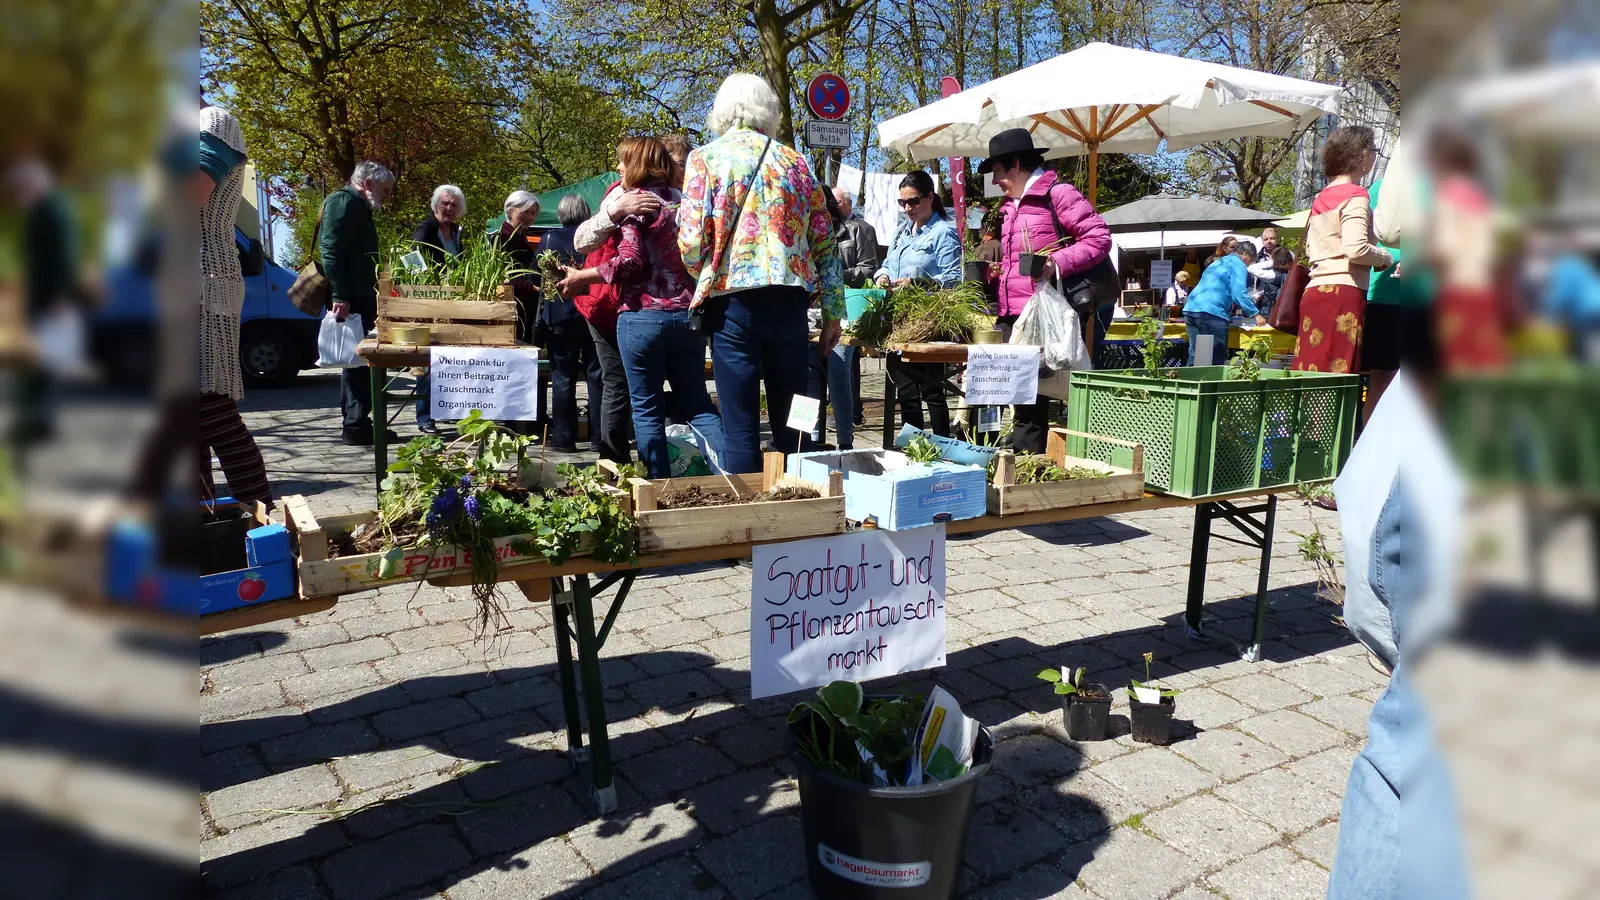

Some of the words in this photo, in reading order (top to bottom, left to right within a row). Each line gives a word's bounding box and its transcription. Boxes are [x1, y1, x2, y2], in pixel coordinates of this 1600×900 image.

[811, 124, 848, 136] Samstags
[973, 352, 993, 360] Vielen
[438, 357, 467, 366] Vielen
[468, 358, 491, 367] Dank
[493, 359, 506, 367] für
[989, 364, 1011, 372] Beitrag
[438, 371, 462, 379] Ihren
[464, 371, 495, 381] Beitrag
[971, 375, 1011, 383] Tauschmarkt
[438, 385, 495, 394] Tauschmarkt
[970, 388, 1011, 396] Organisation.
[438, 400, 496, 409] Organisation.
[921, 491, 964, 505] Speisequark
[765, 590, 944, 651] Pflanzentausch-
[827, 635, 888, 671] markt
[836, 856, 920, 877] hagebaumarkt
